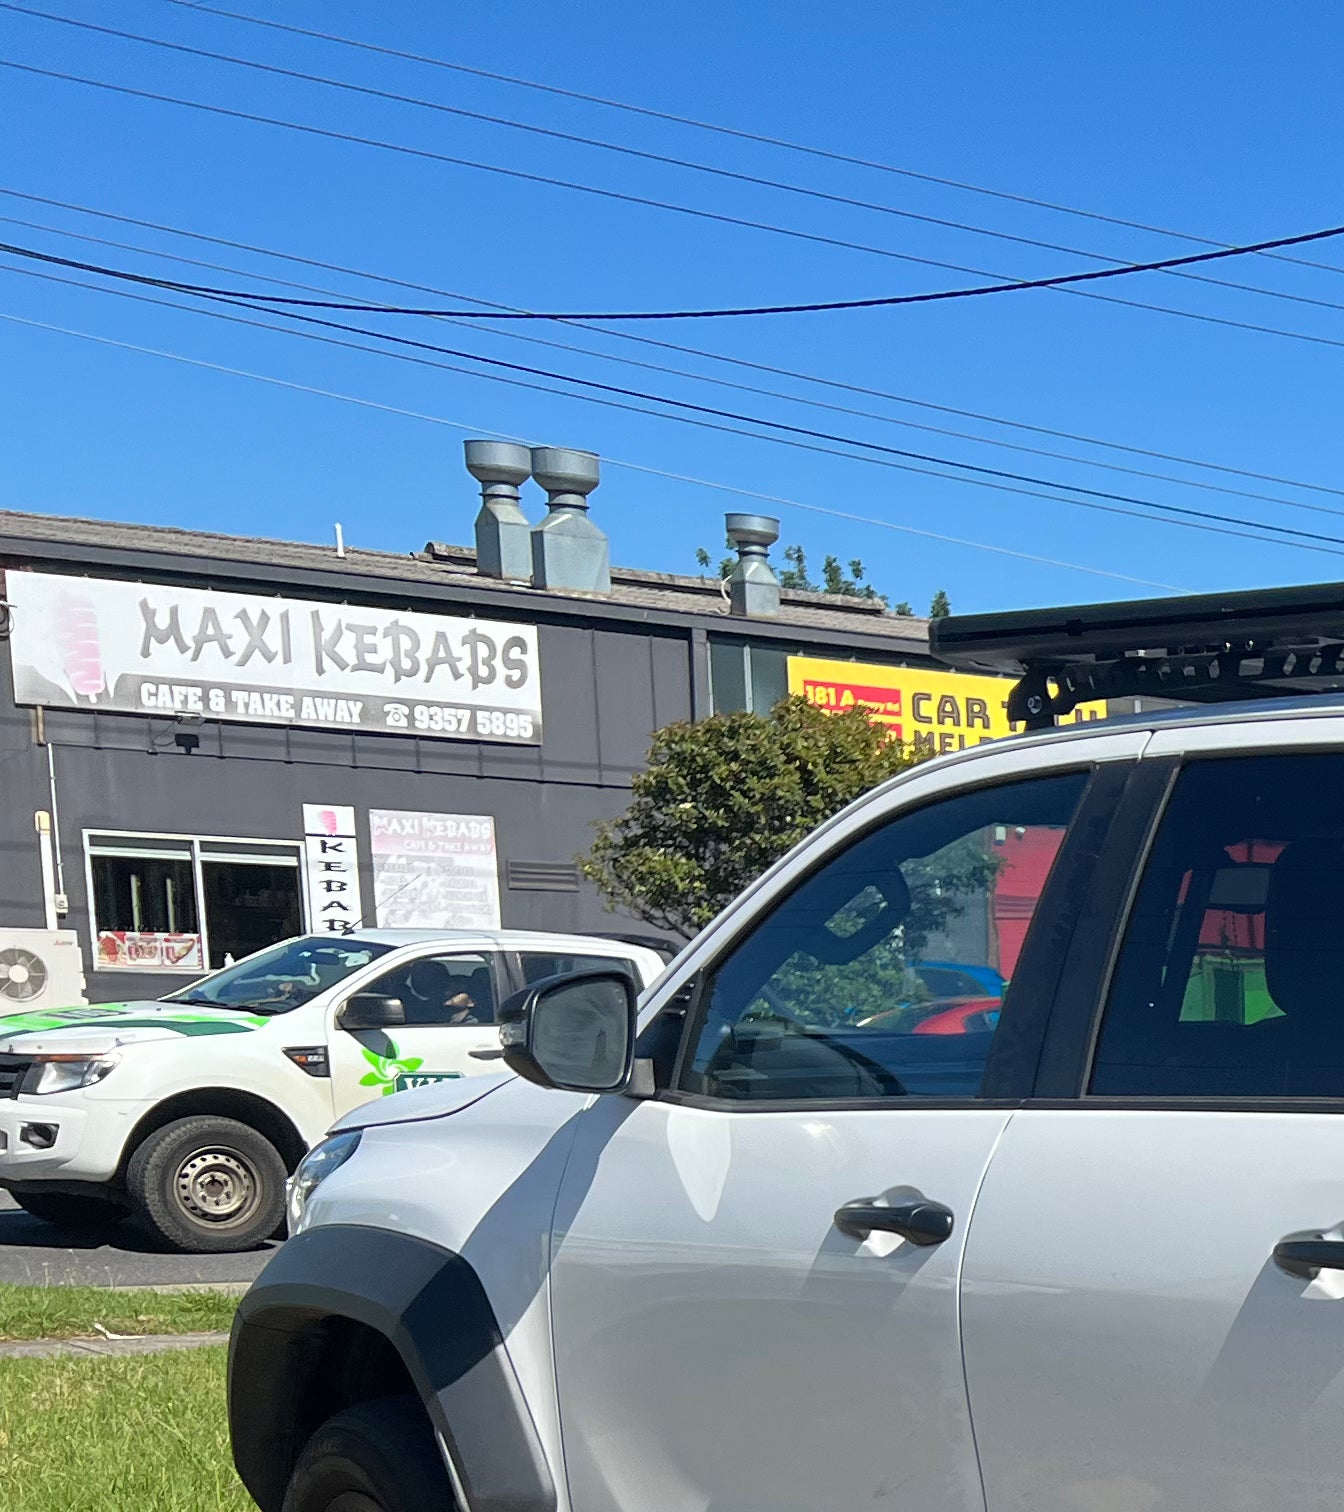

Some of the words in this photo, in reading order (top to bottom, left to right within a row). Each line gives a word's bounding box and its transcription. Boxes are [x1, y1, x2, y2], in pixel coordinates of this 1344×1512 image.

[139, 597, 292, 667] MAXI
[310, 609, 529, 691] KEBABS
[140, 682, 202, 711] CAFE
[208, 688, 225, 712] &
[231, 690, 295, 718] TAKE
[301, 696, 363, 724] AWAY
[413, 705, 471, 732] 9357
[476, 711, 534, 738] 5895
[805, 685, 836, 706] 181
[840, 690, 855, 707] A
[912, 693, 990, 729] CAR
[373, 815, 419, 836] MAXI
[423, 816, 491, 839] KEBABS
